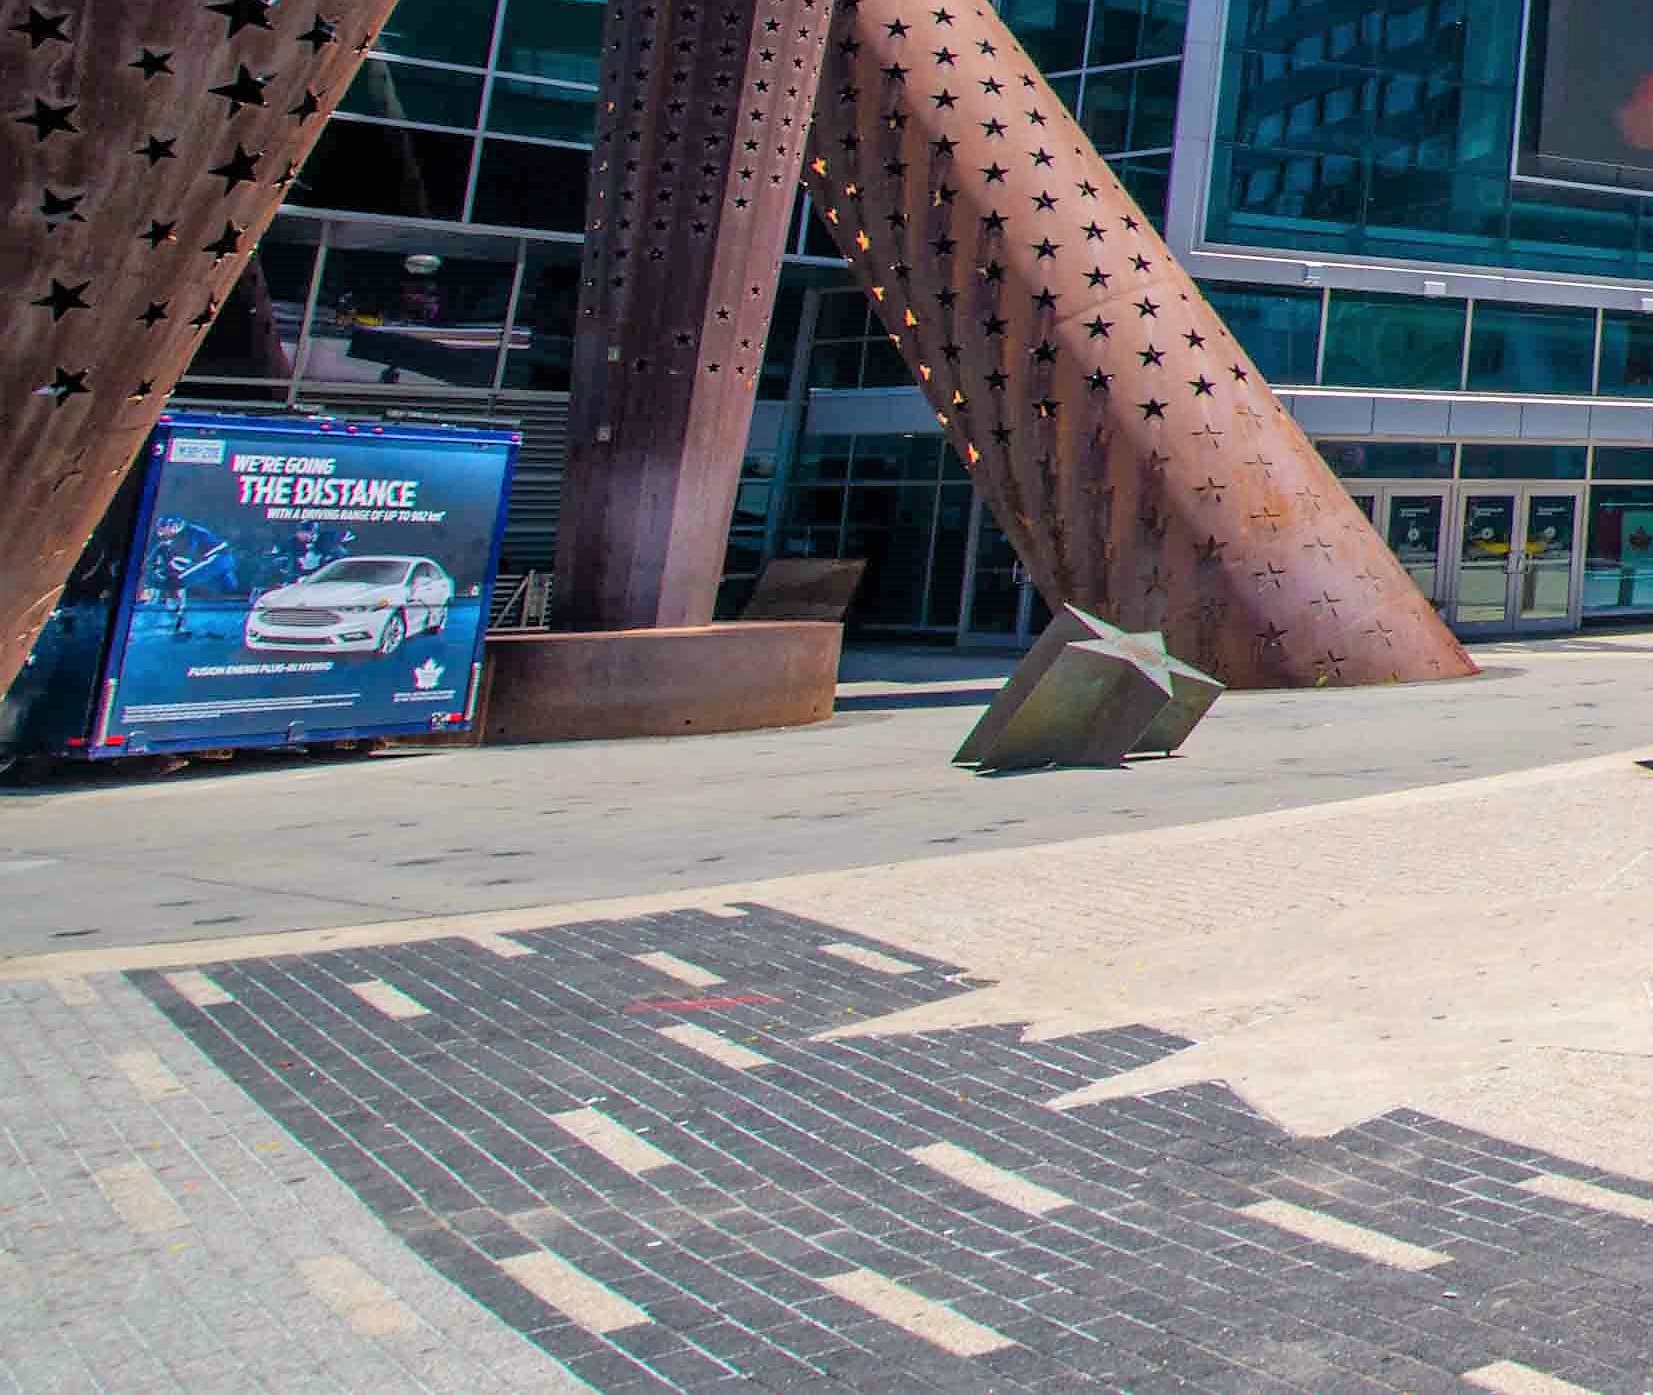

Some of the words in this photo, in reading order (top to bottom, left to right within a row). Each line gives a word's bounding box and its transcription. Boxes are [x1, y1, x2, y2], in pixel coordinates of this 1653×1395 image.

[232, 454, 286, 473] WE'RE
[284, 456, 337, 475] GOING
[239, 474, 295, 506] THE
[292, 477, 420, 508] DISTANCE
